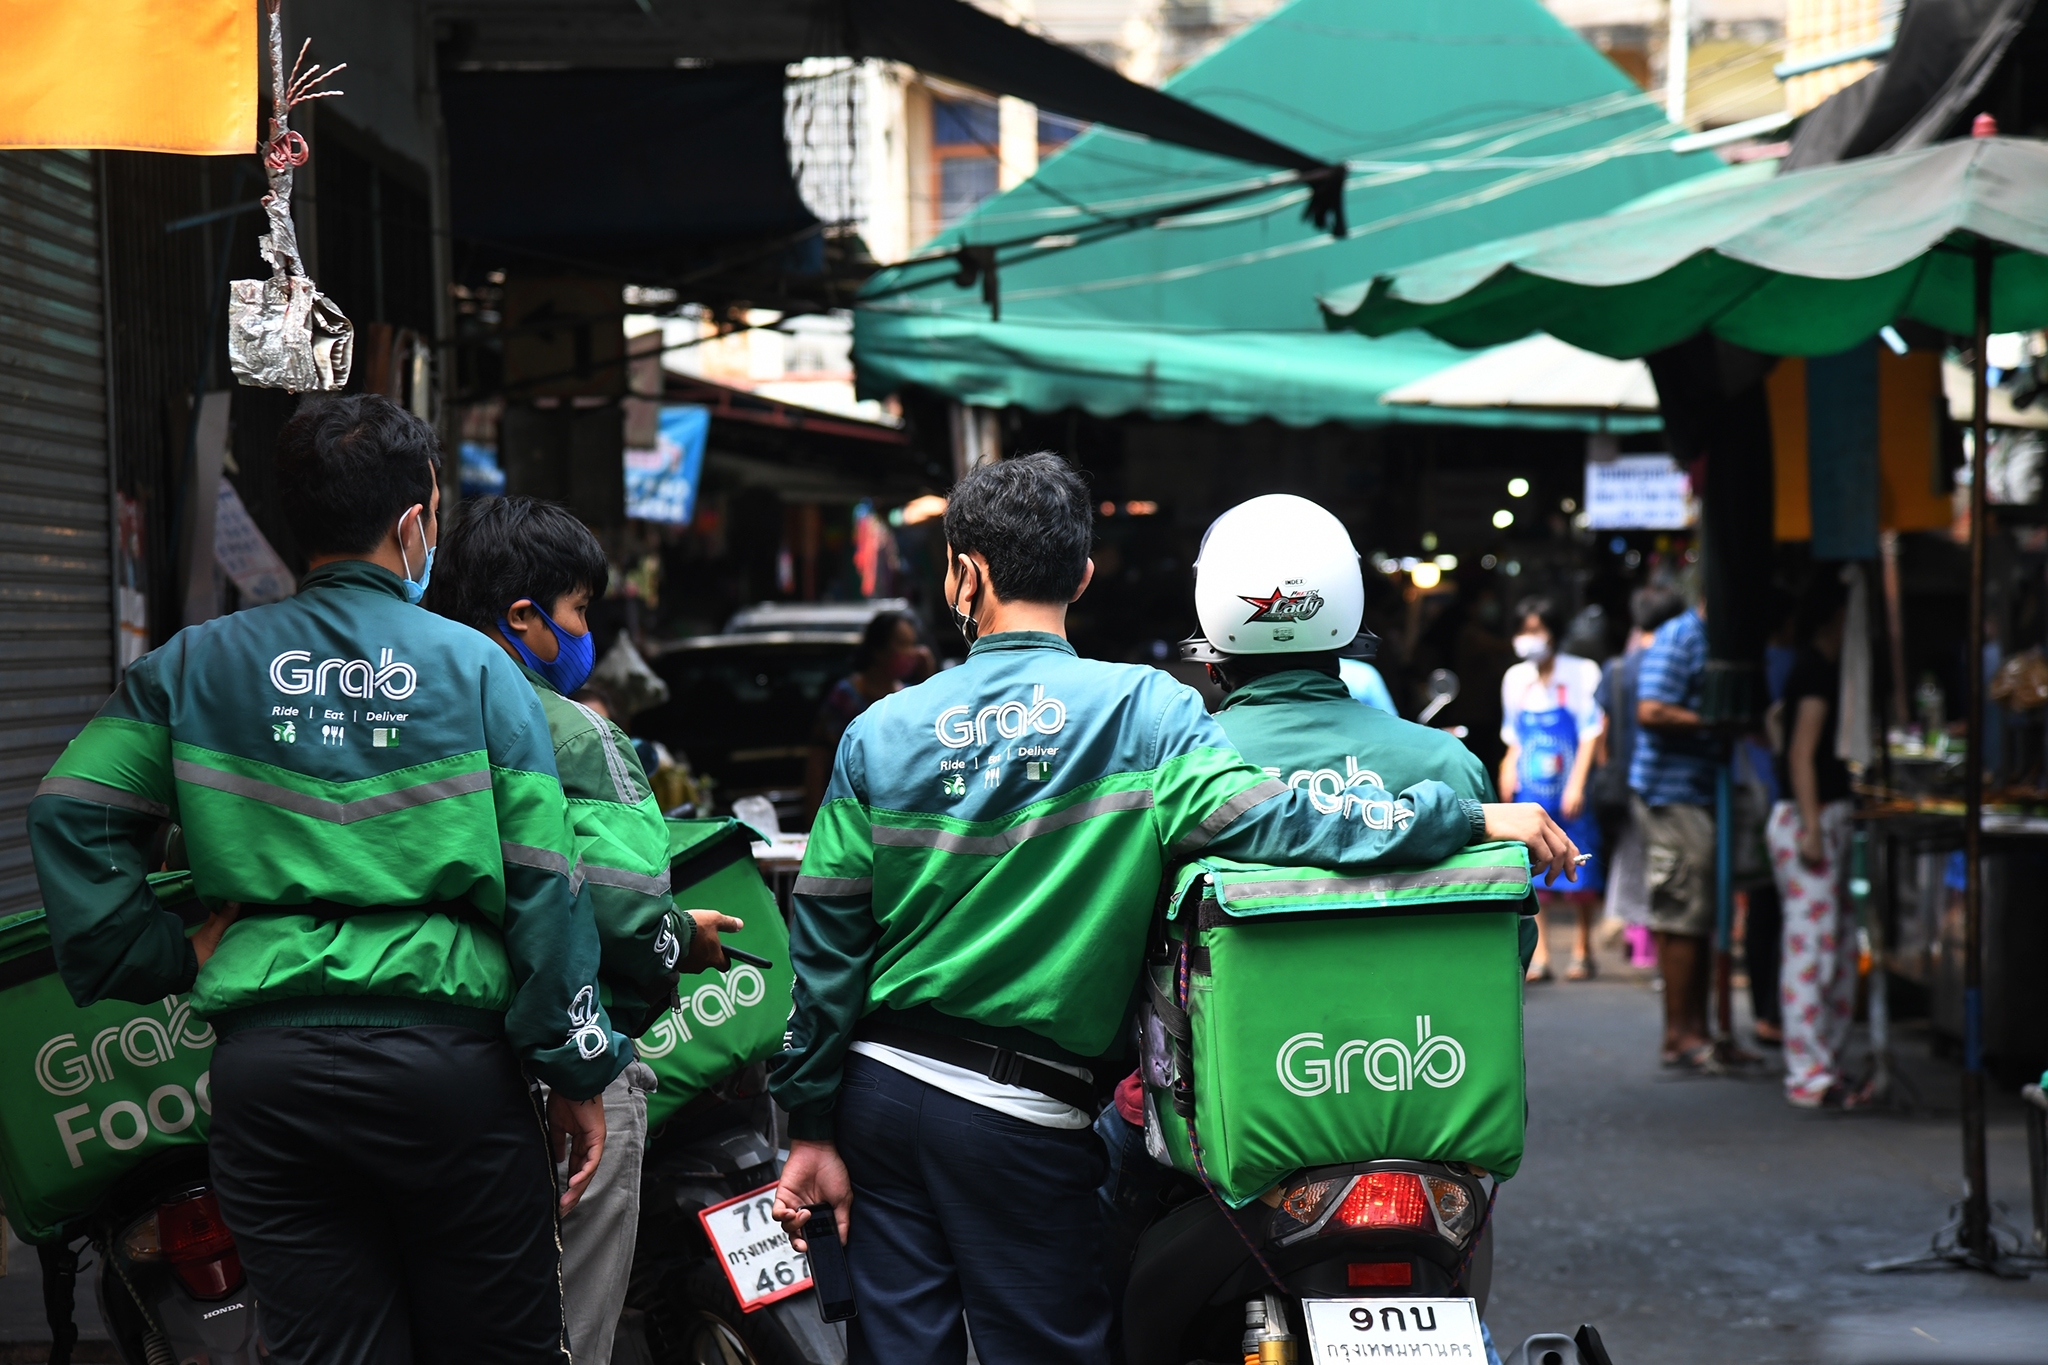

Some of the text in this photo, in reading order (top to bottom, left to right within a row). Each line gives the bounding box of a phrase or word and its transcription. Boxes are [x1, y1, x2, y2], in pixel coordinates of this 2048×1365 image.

[1268, 595, 1323, 620] Lady
[269, 647, 418, 701] Grab
[271, 706, 409, 722] Ride Eat Deliver
[935, 684, 1067, 749] Grab
[940, 760, 966, 771] Ride
[1018, 745, 1060, 757] Deliver
[34, 994, 218, 1097] Grab
[1275, 1015, 1466, 1097] Grab
[203, 1303, 245, 1320] HONDA
[1349, 1306, 1437, 1332] 9กบ
[1327, 1343, 1474, 1363] กรุงเทพมหานคร
